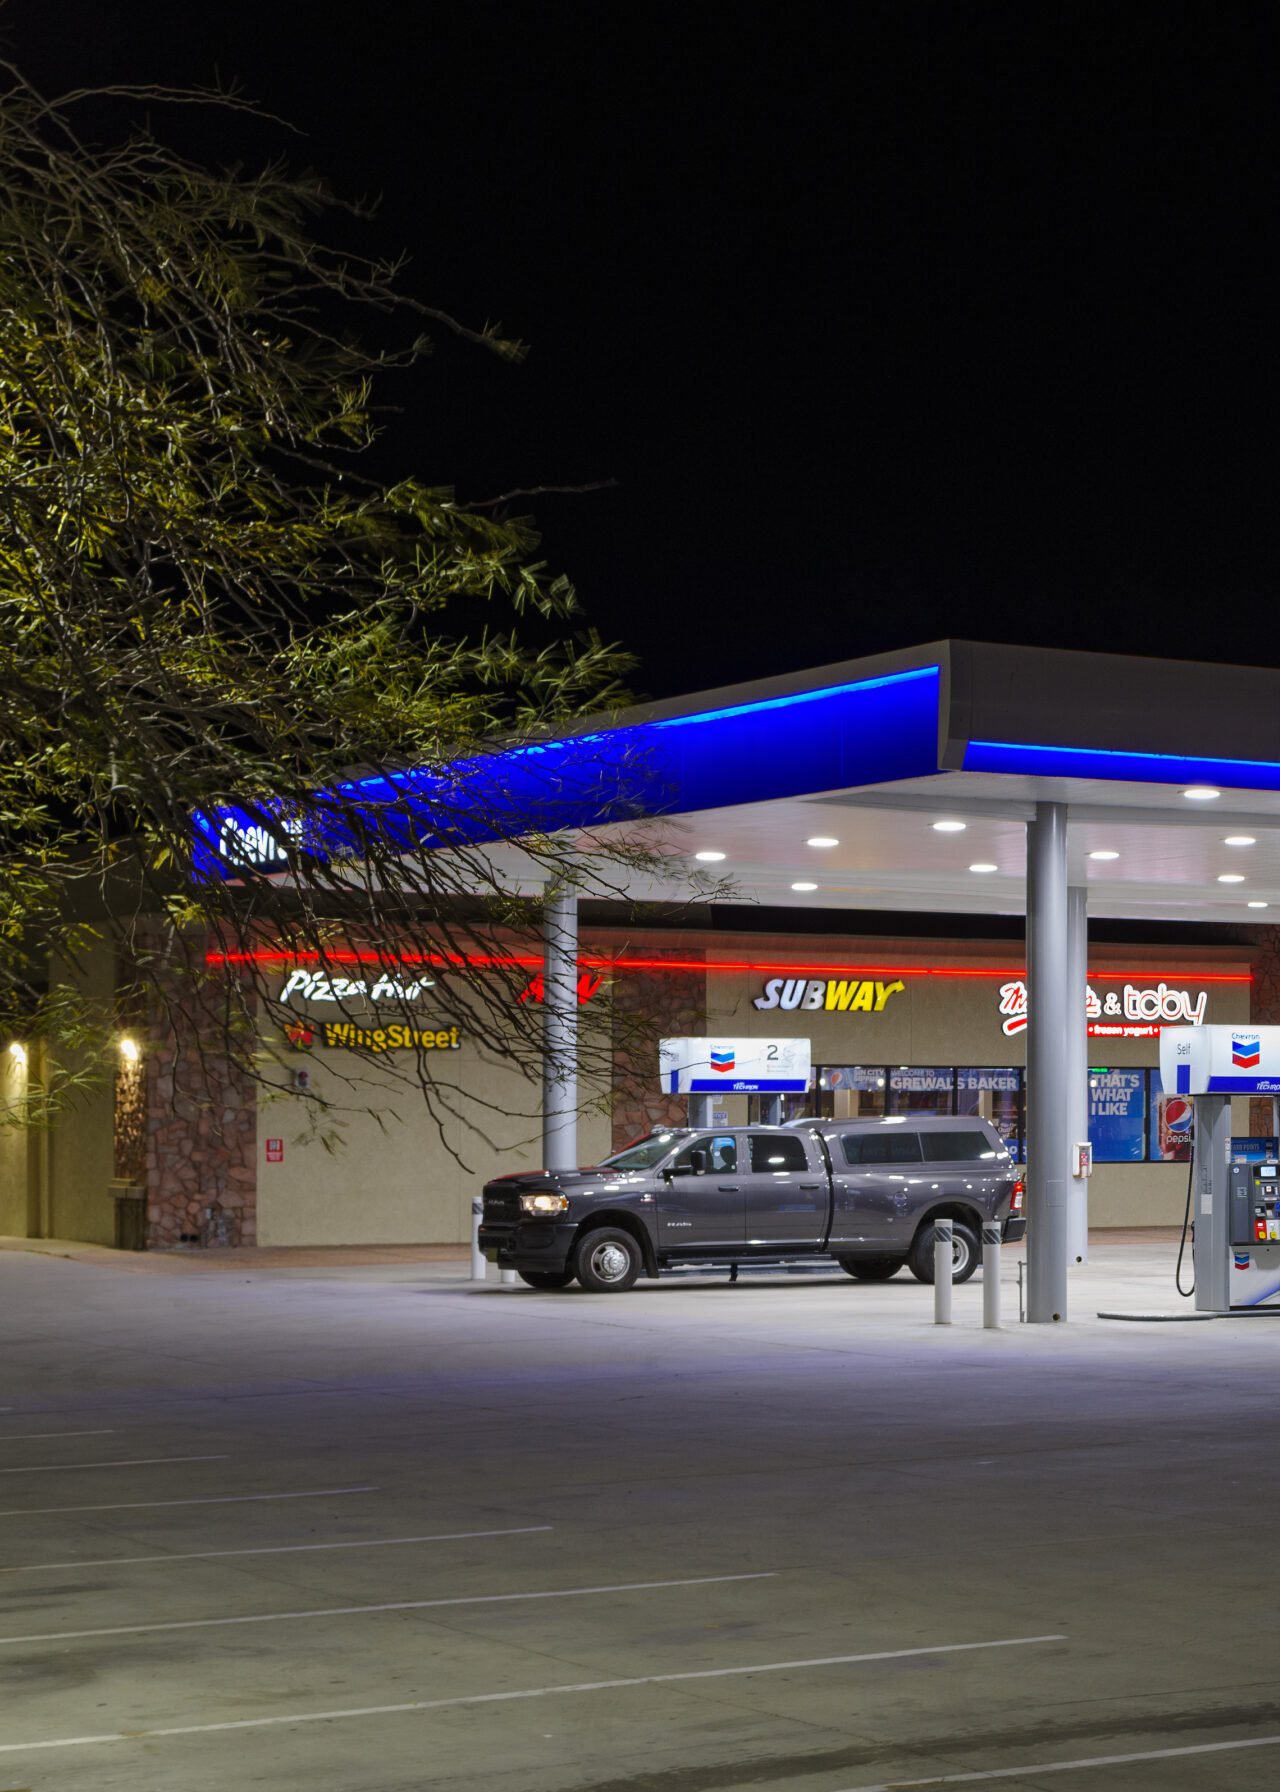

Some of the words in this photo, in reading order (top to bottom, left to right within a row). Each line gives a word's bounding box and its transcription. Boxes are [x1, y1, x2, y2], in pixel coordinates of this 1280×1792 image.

[219, 817, 303, 866] Chev
[280, 969, 367, 1003] Pizza
[752, 978, 906, 1012] SUBWAY
[1103, 991, 1122, 1016] &
[1123, 982, 1208, 1025] tcby
[324, 1021, 462, 1054] WingStreet
[766, 1044, 779, 1060] 2
[967, 1077, 1017, 1091] BAKER
[1091, 1074, 1140, 1087] THAT'S
[1091, 1089, 1134, 1102] WHAT
[1091, 1103, 1096, 1116] I
[1098, 1103, 1128, 1116] LIKE
[1166, 1133, 1191, 1144] pepsi
